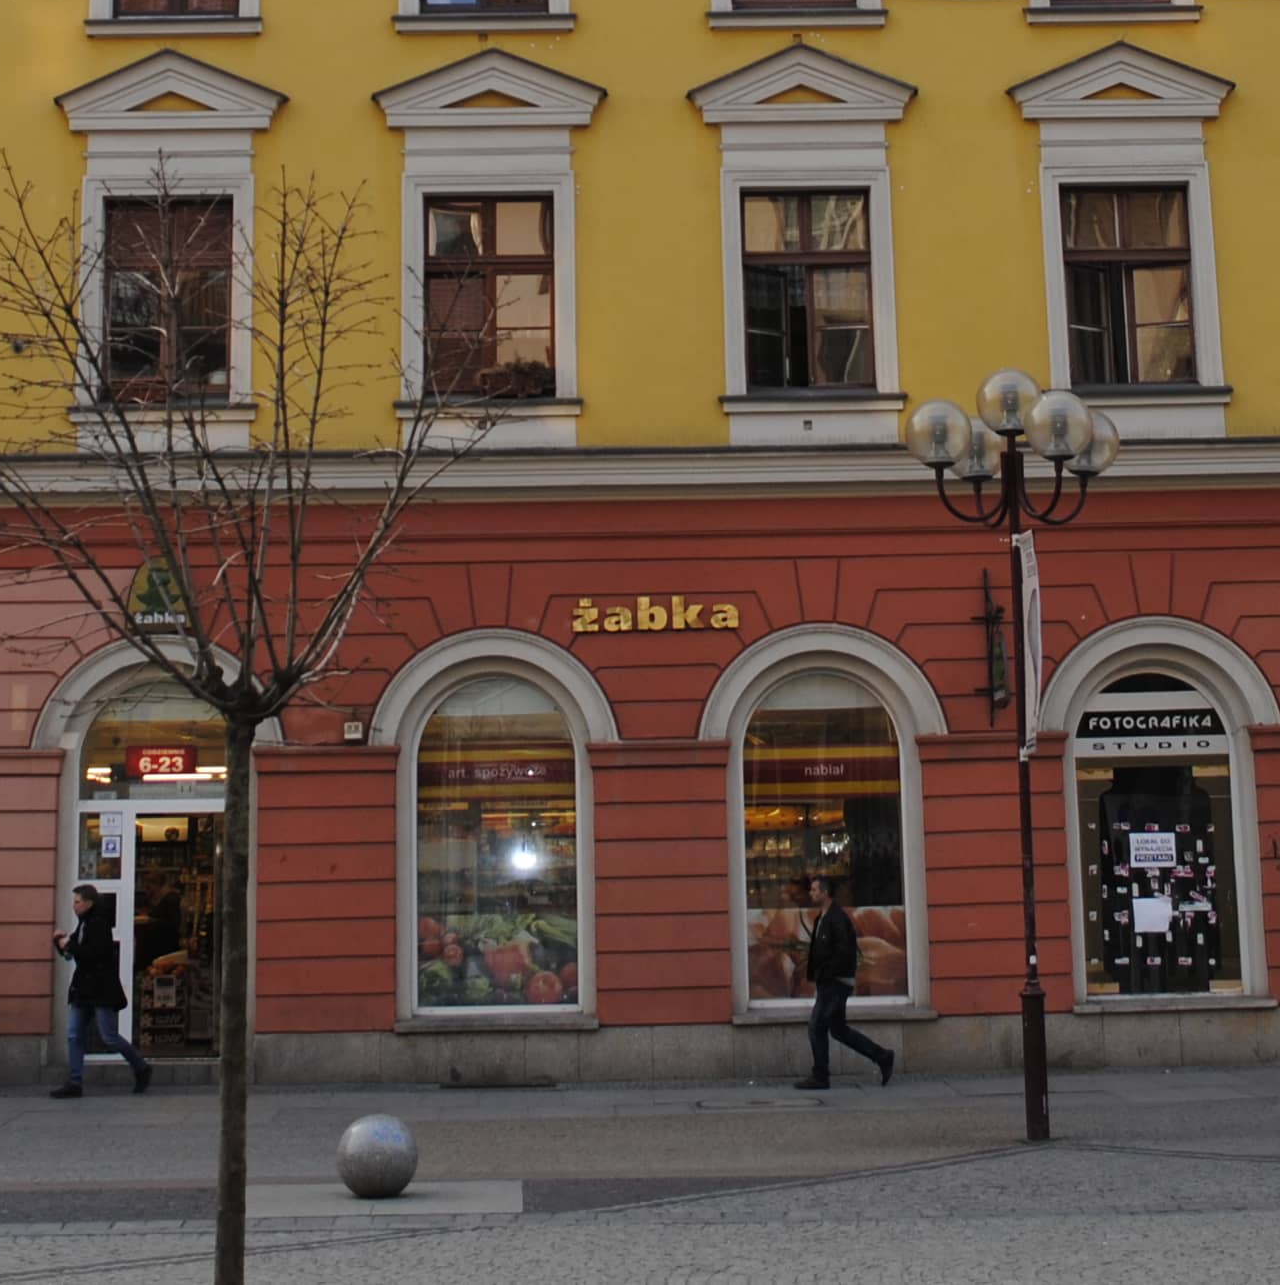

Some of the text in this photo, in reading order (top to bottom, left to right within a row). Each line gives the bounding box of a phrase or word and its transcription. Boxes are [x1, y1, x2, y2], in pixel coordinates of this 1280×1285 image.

[572, 595, 740, 632] żabka
[1088, 715, 1212, 730] FOTOGRAFIKA
[1092, 740, 1210, 751] STUDIO
[138, 756, 184, 773] 6-23
